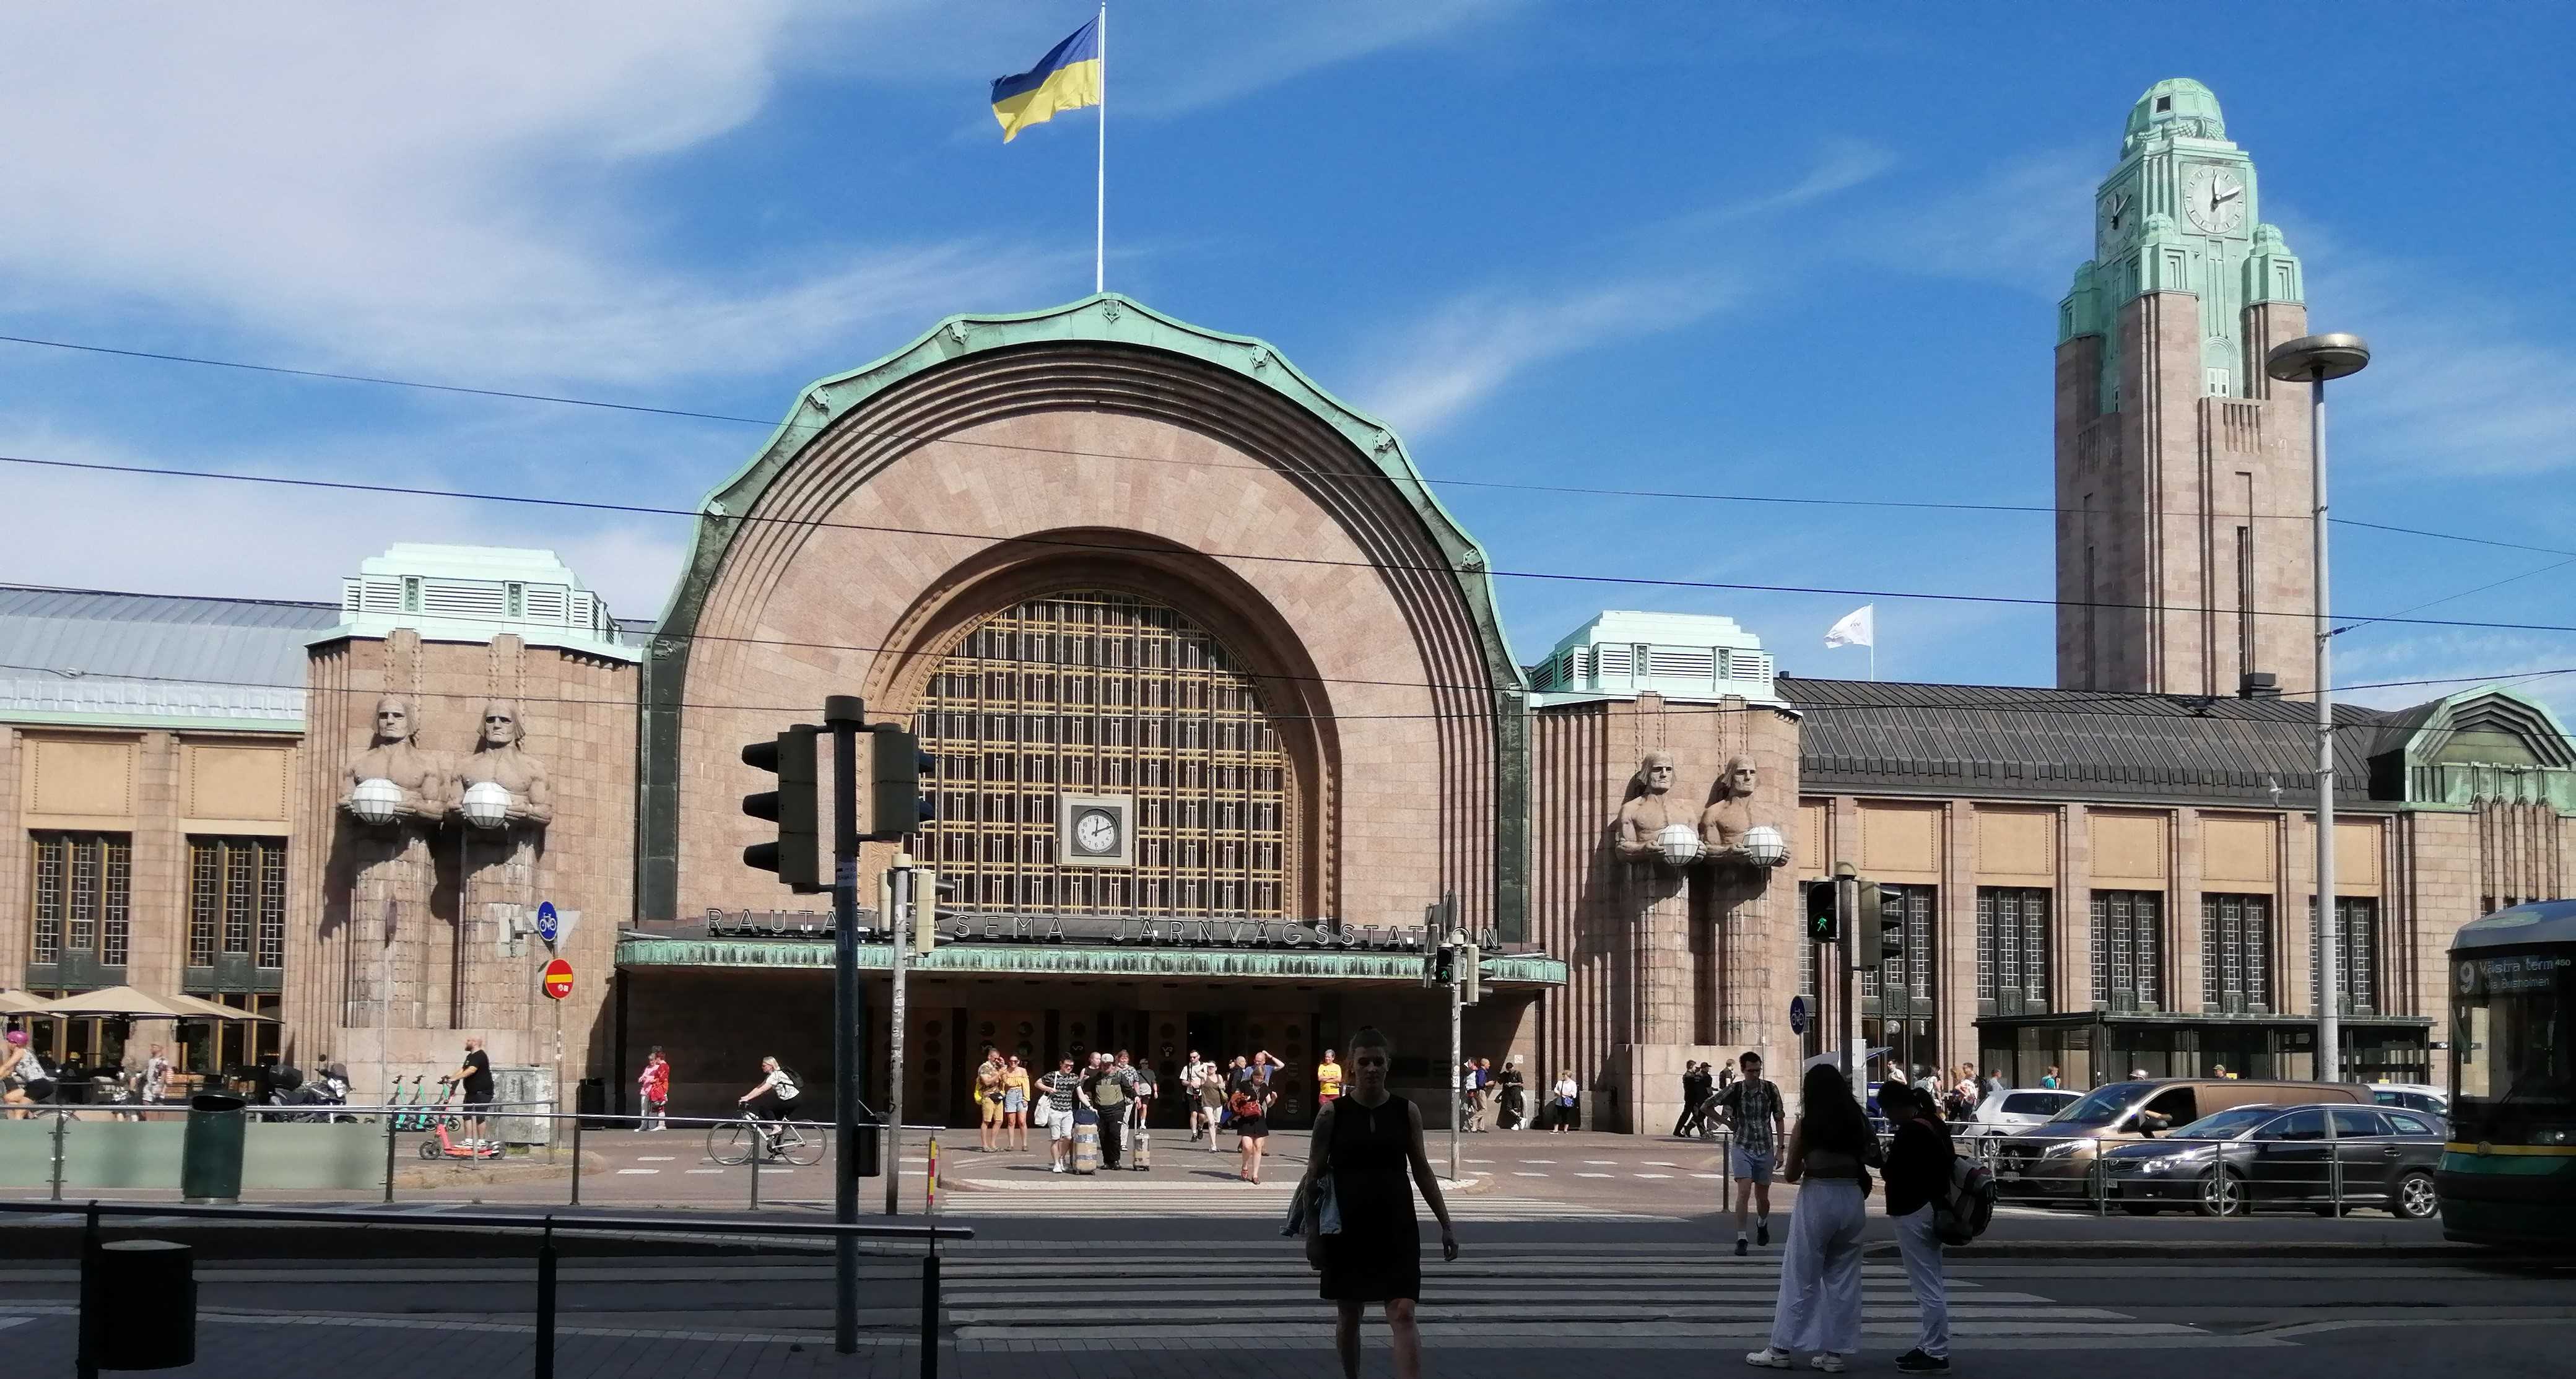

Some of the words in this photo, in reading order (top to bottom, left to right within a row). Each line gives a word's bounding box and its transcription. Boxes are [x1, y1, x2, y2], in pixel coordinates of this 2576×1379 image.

[706, 908, 1066, 941] RAUTAISEMA
[2460, 961, 2475, 994] 9
[2479, 960, 2521, 974] Västra
[2525, 957, 2554, 972] term
